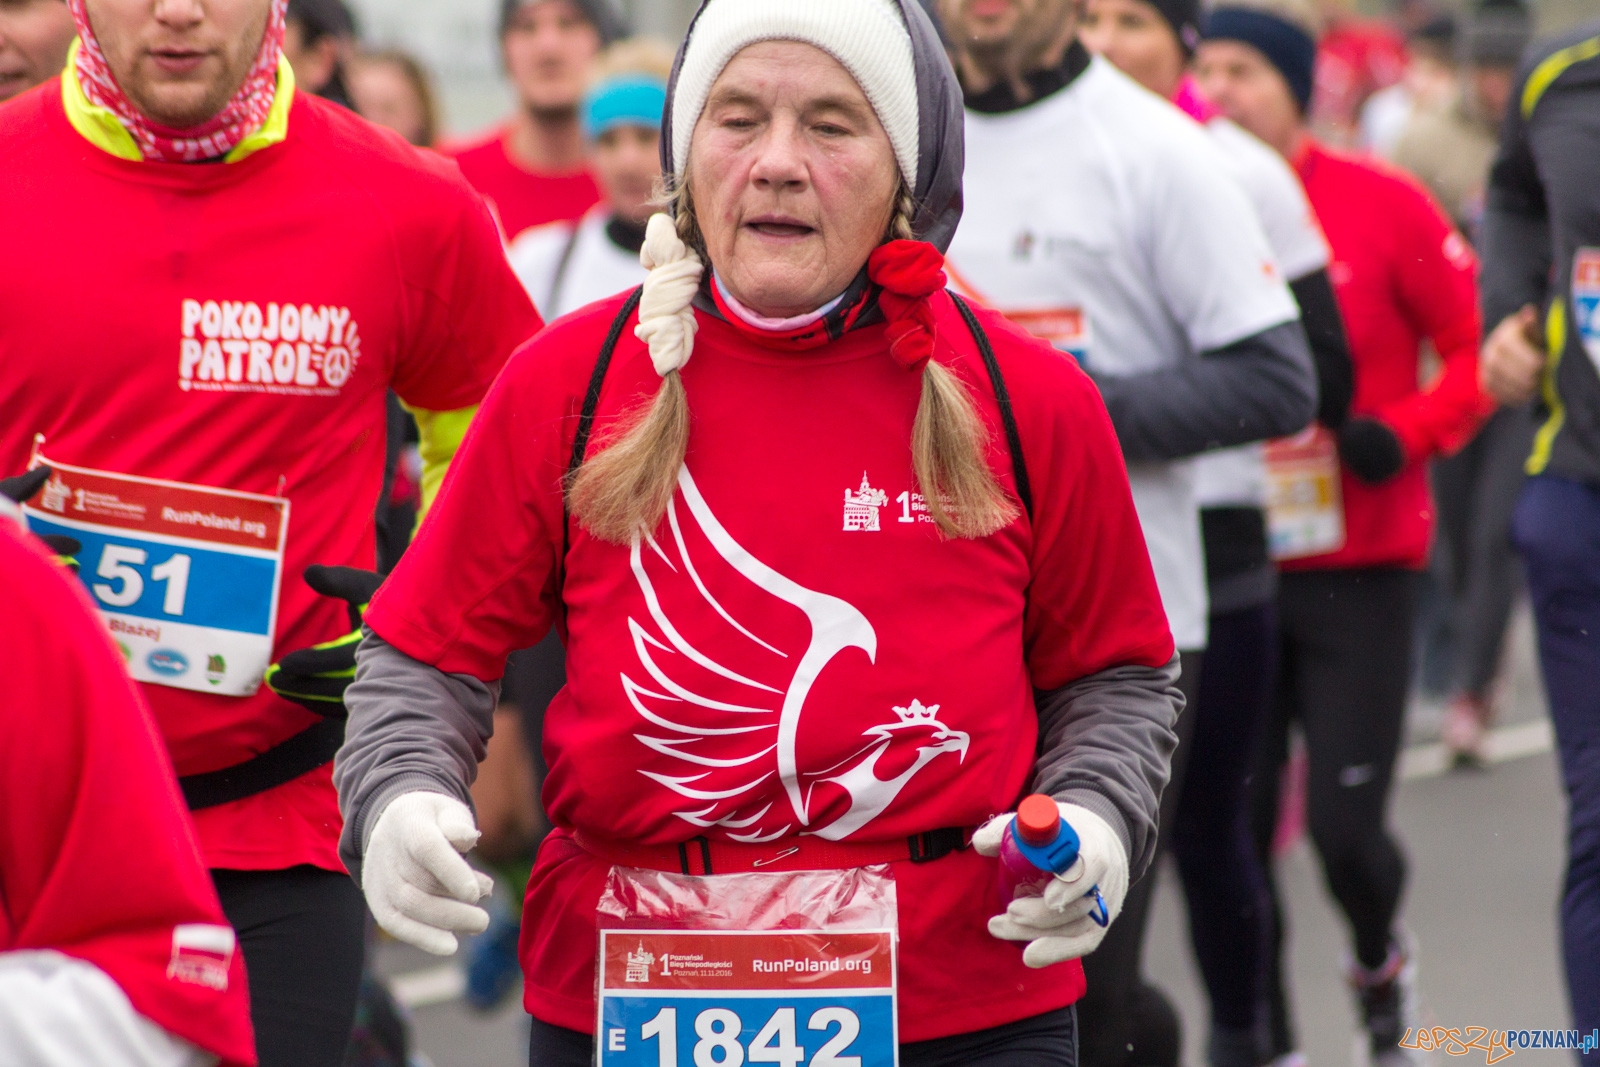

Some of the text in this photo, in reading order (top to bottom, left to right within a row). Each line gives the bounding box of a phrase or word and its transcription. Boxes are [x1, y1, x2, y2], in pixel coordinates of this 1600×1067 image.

[181, 298, 350, 345] POKOJOWY
[179, 338, 319, 386] PATROL
[161, 506, 266, 538] RunPoland.org
[896, 491, 914, 522] 1
[92, 543, 192, 616] 51
[660, 953, 672, 976] 1
[752, 958, 872, 974] RunPoland.org
[608, 1006, 862, 1067] E 1842
